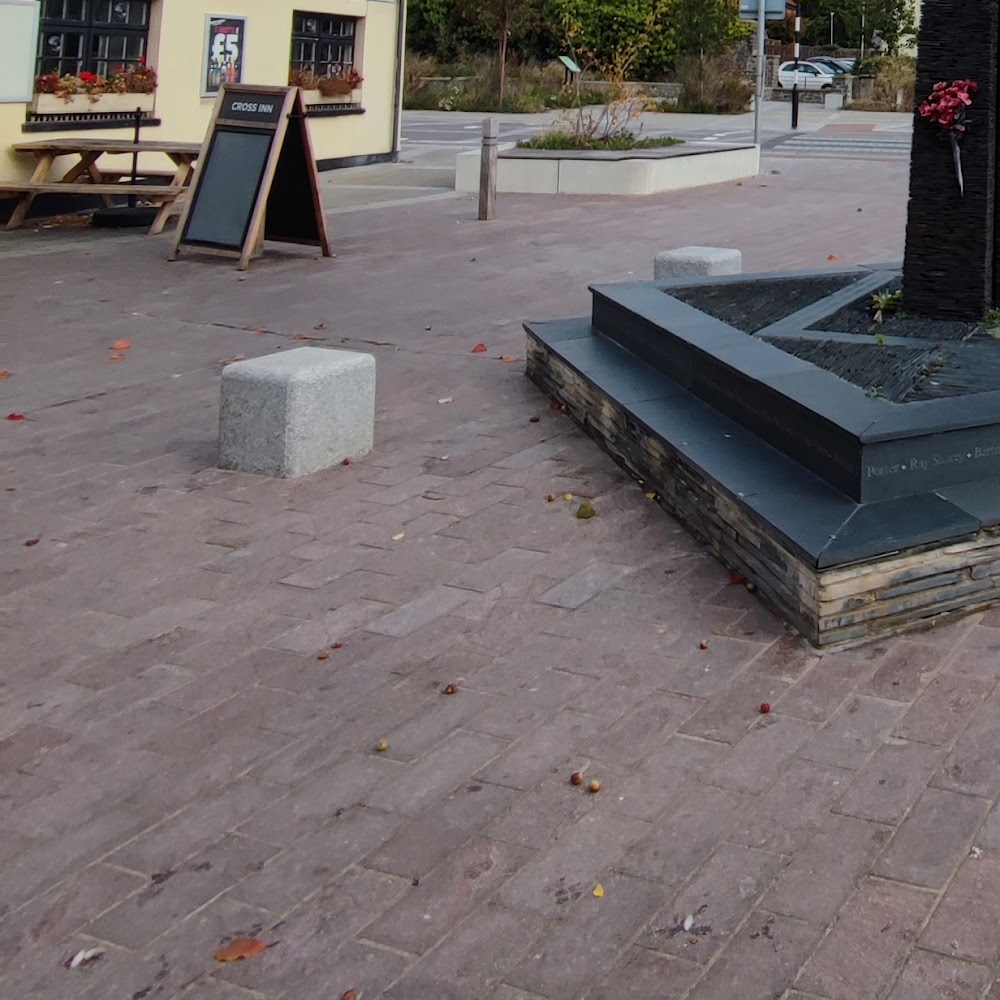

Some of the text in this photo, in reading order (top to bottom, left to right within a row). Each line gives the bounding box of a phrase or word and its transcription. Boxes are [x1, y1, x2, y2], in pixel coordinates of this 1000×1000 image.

[211, 33, 239, 62] £5
[231, 101, 274, 113] CROSS INN
